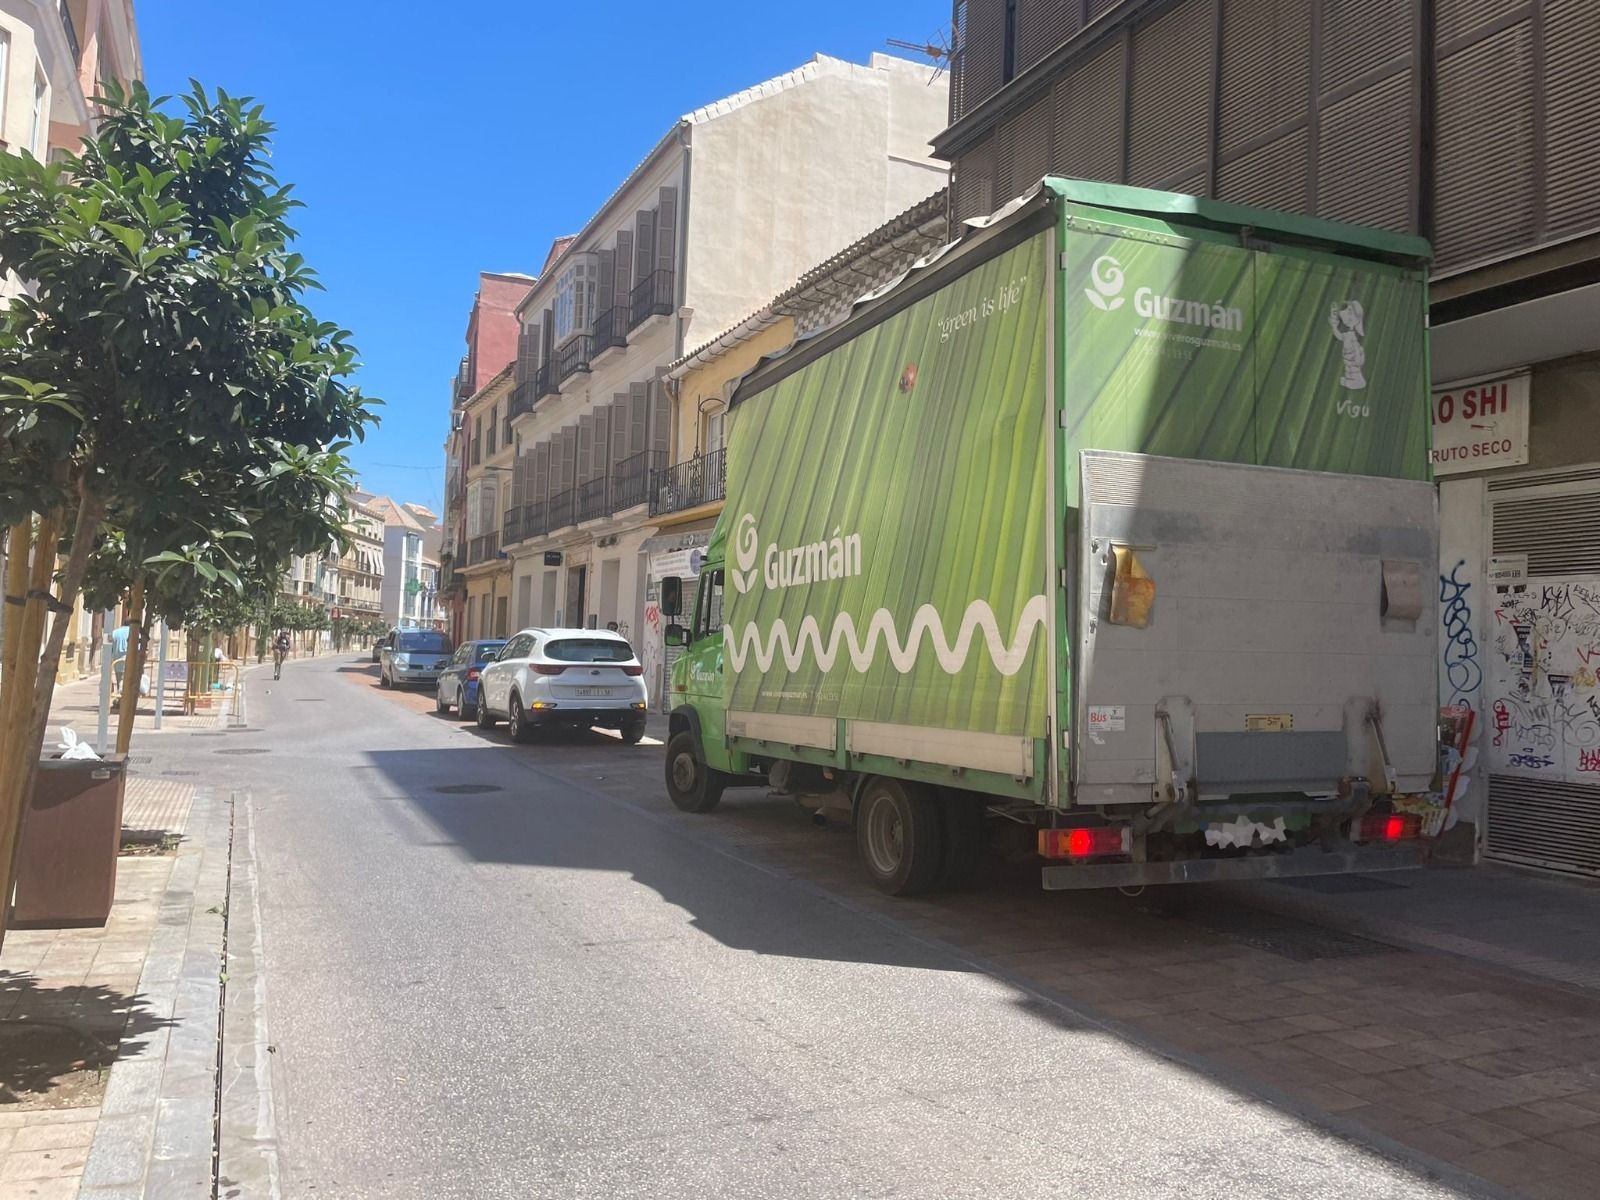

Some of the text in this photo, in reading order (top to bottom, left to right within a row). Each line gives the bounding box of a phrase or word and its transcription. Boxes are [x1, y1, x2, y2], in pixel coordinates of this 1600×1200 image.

[982, 297, 994, 318] is
[1134, 286, 1243, 332] Guzmán
[1432, 383, 1508, 425] O SHI
[1472, 439, 1512, 457] SECO
[764, 524, 861, 590] Guzmán
[1090, 711, 1107, 723] Bus
